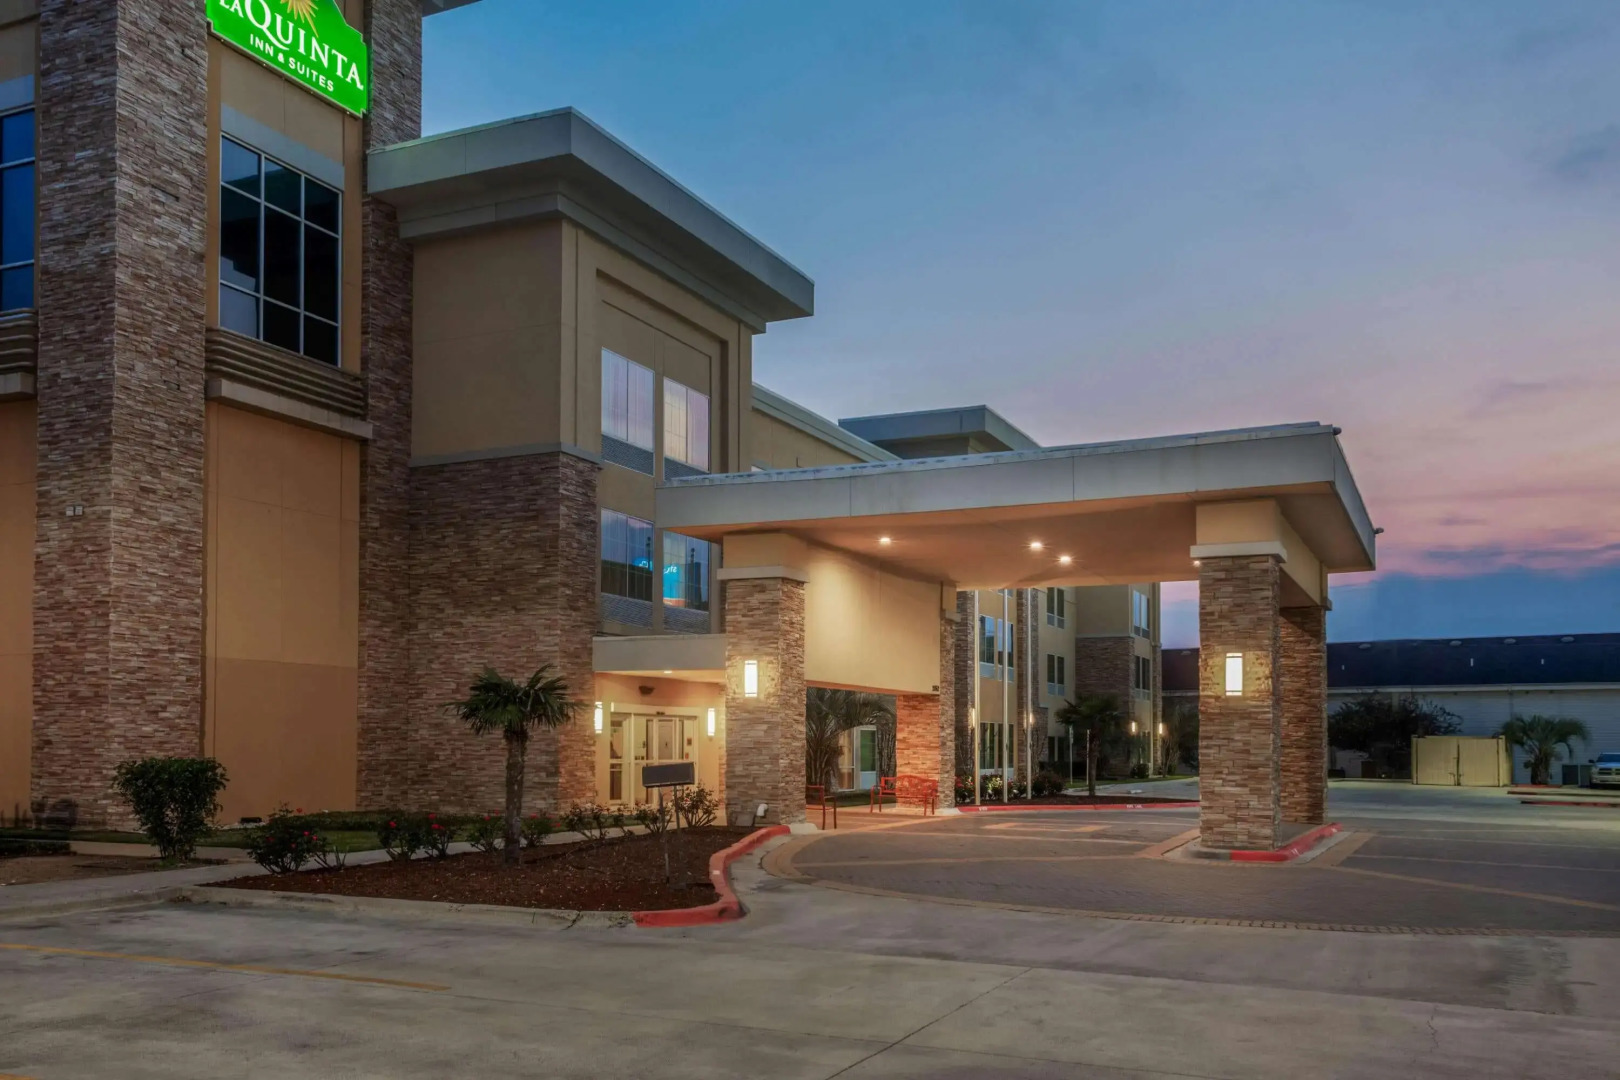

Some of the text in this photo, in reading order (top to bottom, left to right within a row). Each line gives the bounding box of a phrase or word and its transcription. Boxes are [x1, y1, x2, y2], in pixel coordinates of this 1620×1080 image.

[245, 0, 364, 91] QUINTA
[250, 33, 334, 92] INN & SUITES
